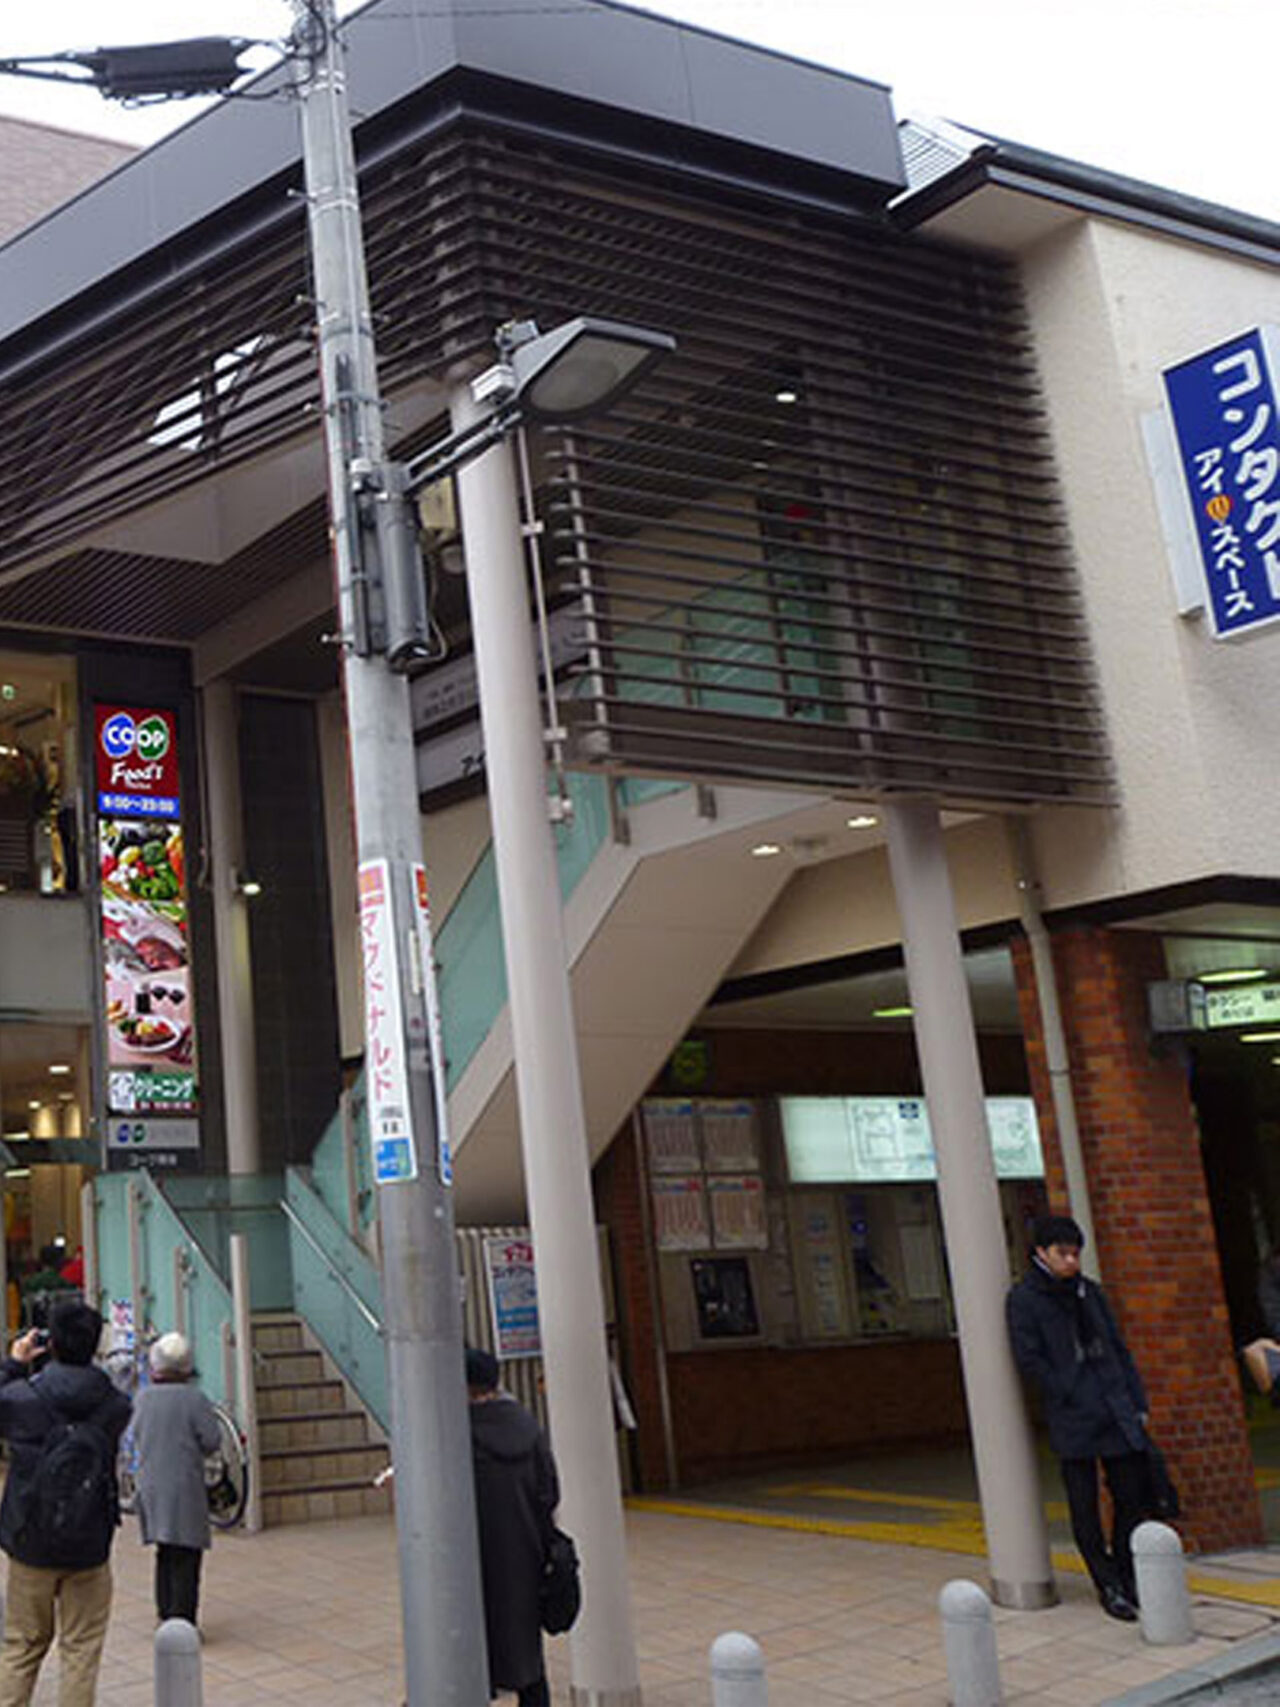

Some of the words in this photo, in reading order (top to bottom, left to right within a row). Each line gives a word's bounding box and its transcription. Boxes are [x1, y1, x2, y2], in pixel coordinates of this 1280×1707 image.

[1195, 448, 1224, 494] アイ
[1211, 525, 1255, 618] スペース
[107, 726, 165, 748] COOP
